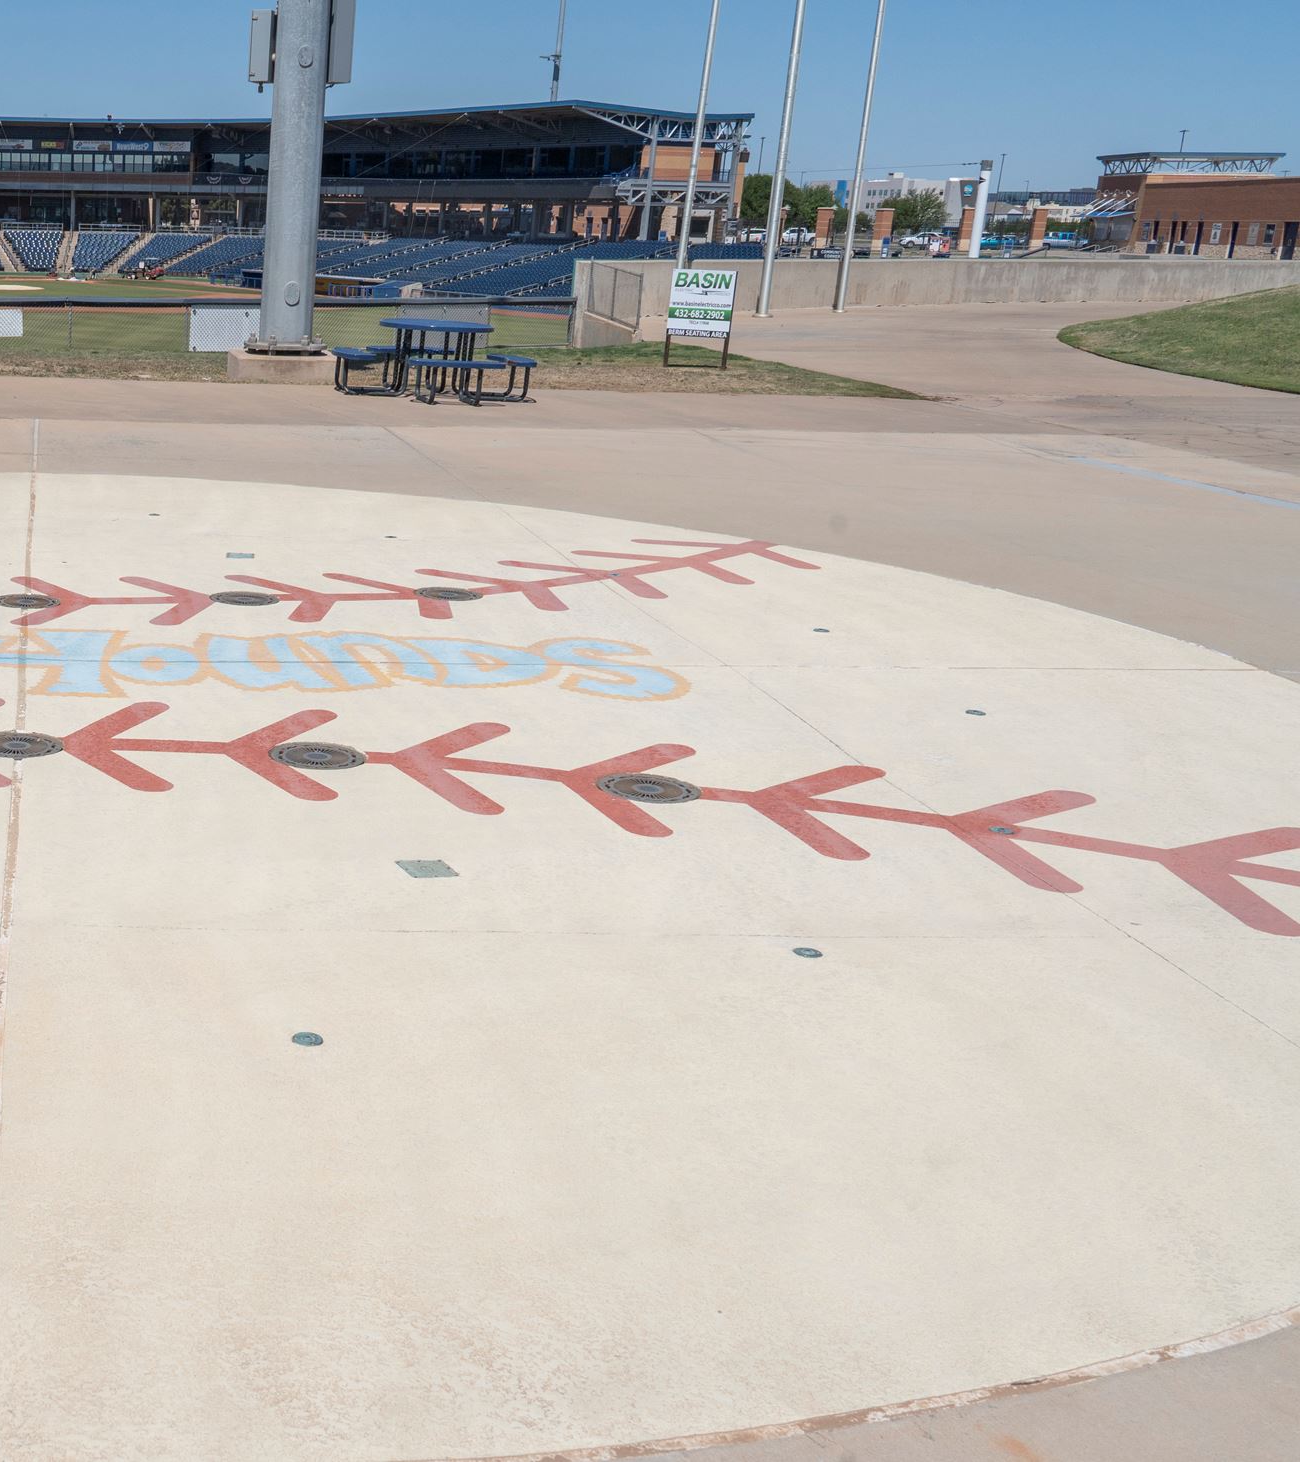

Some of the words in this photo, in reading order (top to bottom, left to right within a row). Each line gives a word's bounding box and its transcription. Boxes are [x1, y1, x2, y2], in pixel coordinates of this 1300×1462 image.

[674, 272, 733, 289] BASIN
[674, 308, 725, 320] 432-682-2902
[668, 328, 685, 336] BERM
[685, 329, 711, 337] SEATING
